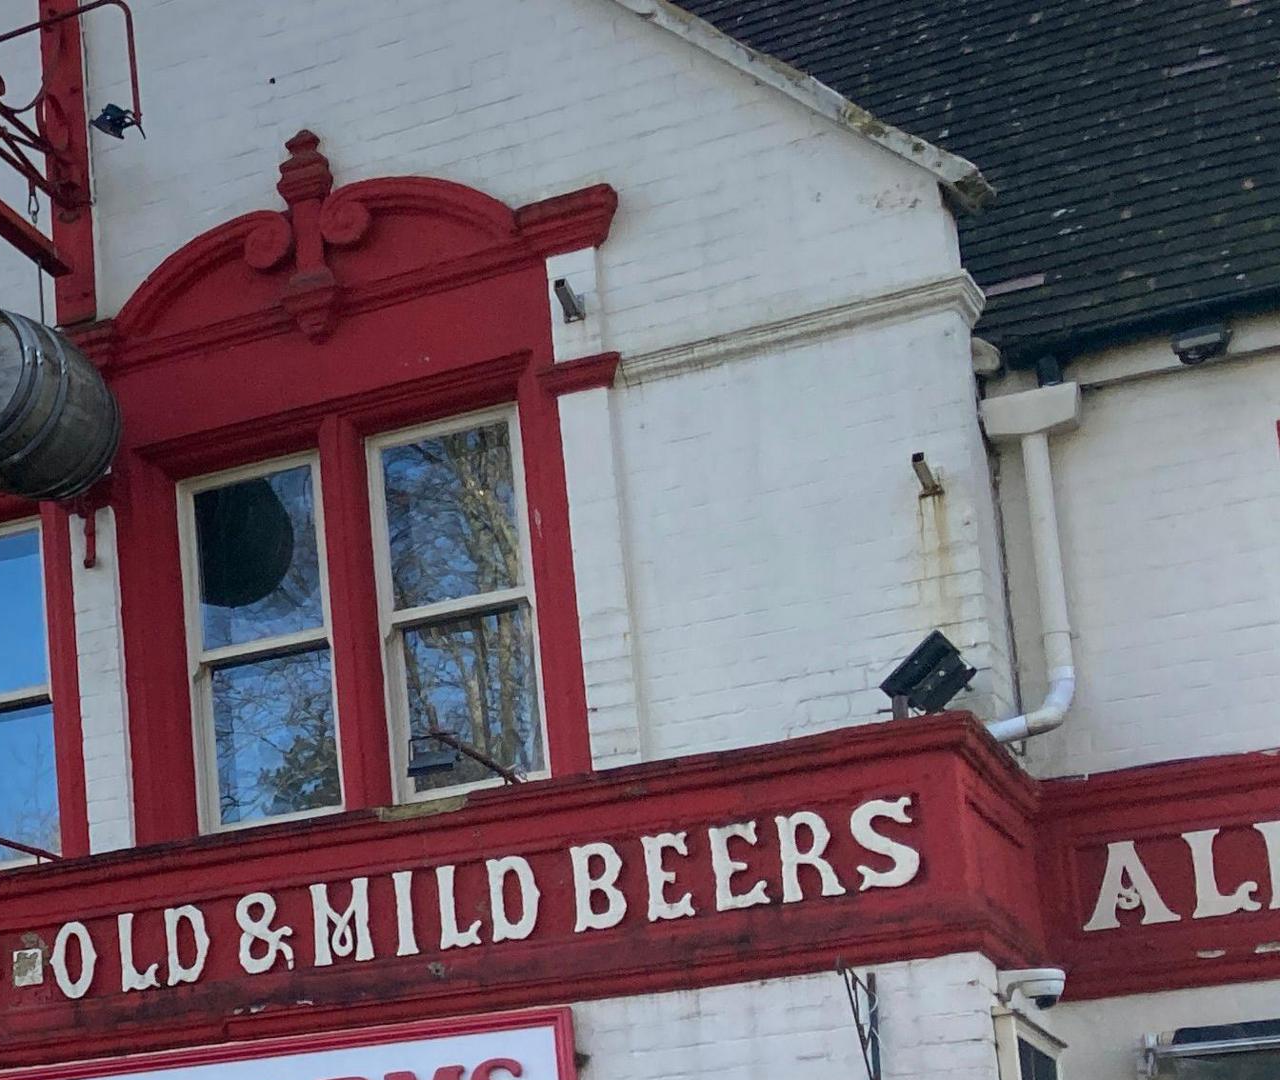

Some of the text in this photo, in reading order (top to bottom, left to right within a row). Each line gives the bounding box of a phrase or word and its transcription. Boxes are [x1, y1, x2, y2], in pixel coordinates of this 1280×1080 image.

[49, 904, 210, 999] OLD
[236, 891, 295, 975] &
[309, 854, 540, 968] MILD
[568, 796, 921, 934] BEERS
